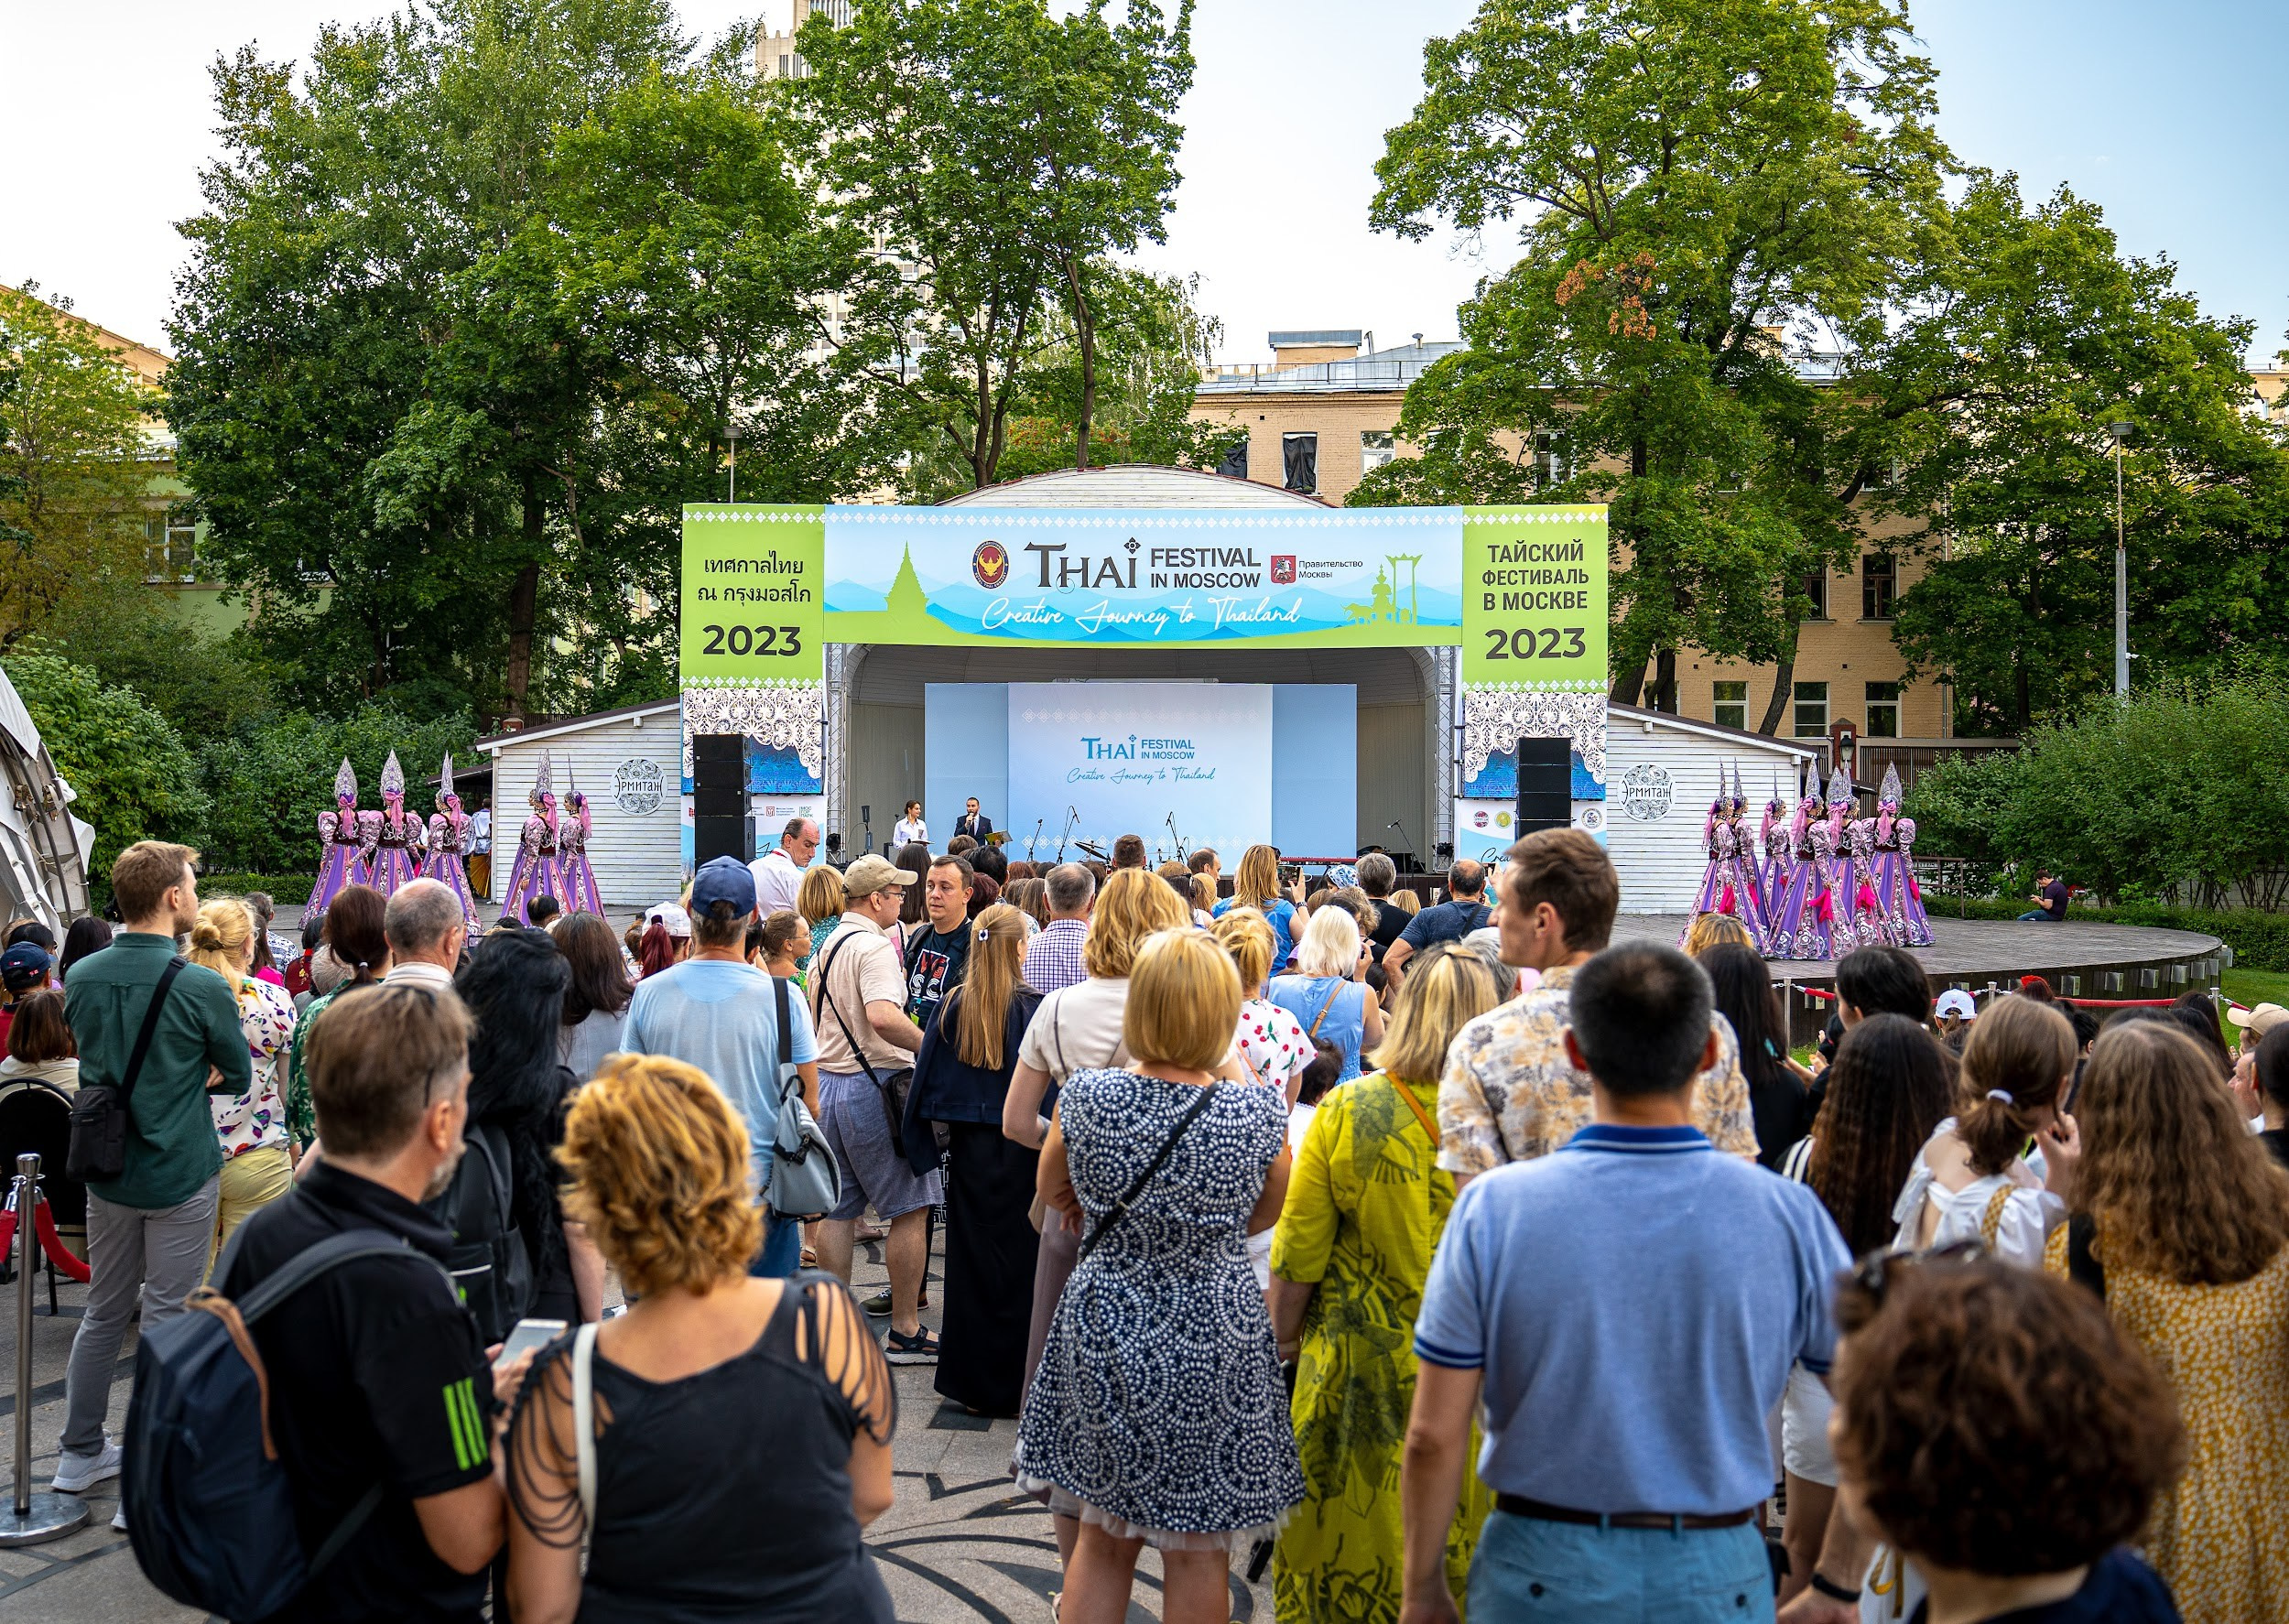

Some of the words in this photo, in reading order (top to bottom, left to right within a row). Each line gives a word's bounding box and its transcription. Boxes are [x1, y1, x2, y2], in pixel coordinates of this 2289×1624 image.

[1150, 547, 1262, 568] FESTIVAL
[1487, 538, 1584, 563] ТАЙСКИЙ
[704, 549, 804, 574] เทศกาลไทย
[1298, 560, 1363, 569] Правительство
[1150, 573, 1167, 589] IN
[1174, 572, 1262, 589] MOSCOW
[1298, 570, 1333, 579] Москвы
[1481, 568, 1589, 587] ФЕСТИВАЛЬ
[698, 587, 718, 601] ณ
[723, 579, 811, 607] กรุงมอสโก
[1483, 592, 1496, 611] В
[1502, 590, 1588, 611] МОСКВЕ
[982, 597, 1065, 630] Creative
[1075, 599, 1170, 636] Journey
[1170, 597, 1197, 624] to
[1207, 594, 1303, 631] Thailand
[702, 624, 802, 656] 2023
[1484, 627, 1586, 659] 2023
[1141, 739, 1195, 750] FESTIVAL
[1141, 751, 1150, 760] IN
[1152, 751, 1195, 760] MOSCOW
[1067, 767, 1106, 784] Creative
[1110, 768, 1155, 785] Journey
[1154, 767, 1166, 780] to
[1171, 766, 1216, 783] Thailand
[1481, 847, 1511, 862] Crea
